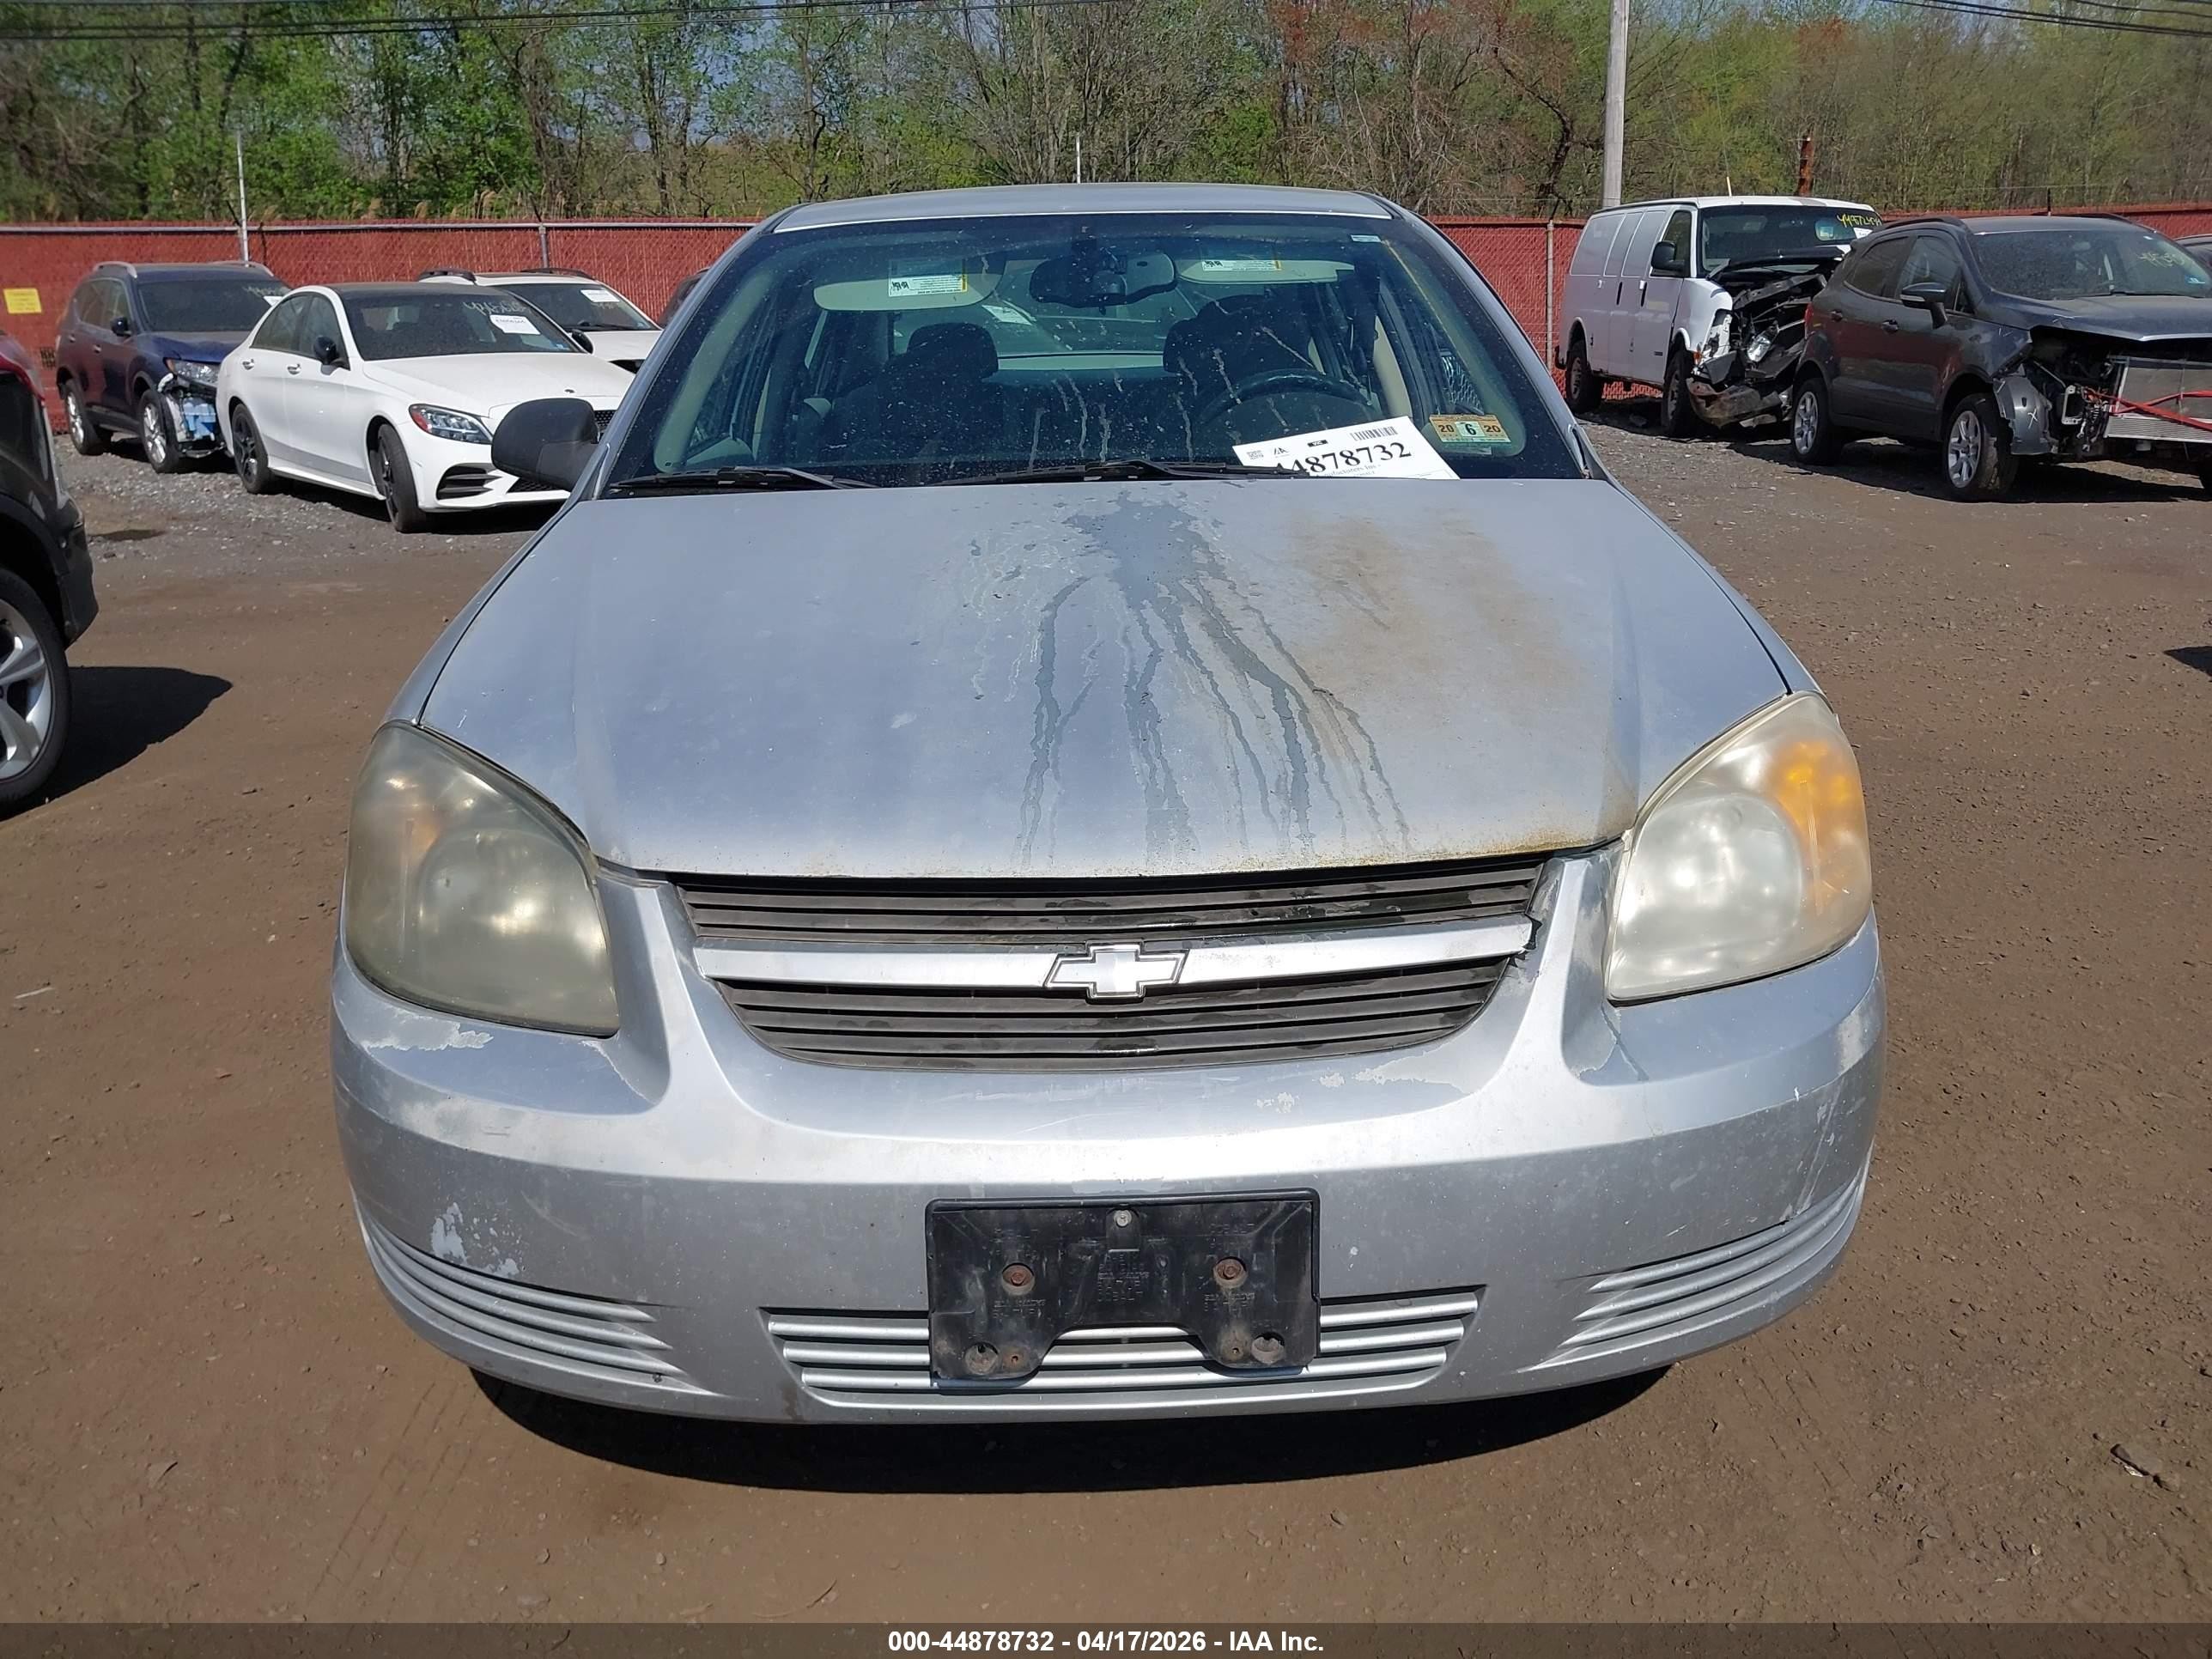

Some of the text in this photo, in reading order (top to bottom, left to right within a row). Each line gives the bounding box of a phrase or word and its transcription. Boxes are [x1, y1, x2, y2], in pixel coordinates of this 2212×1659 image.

[1438, 424, 1455, 433] 20
[1465, 423, 1477, 435] 6
[1276, 441, 1412, 474] 4878732
